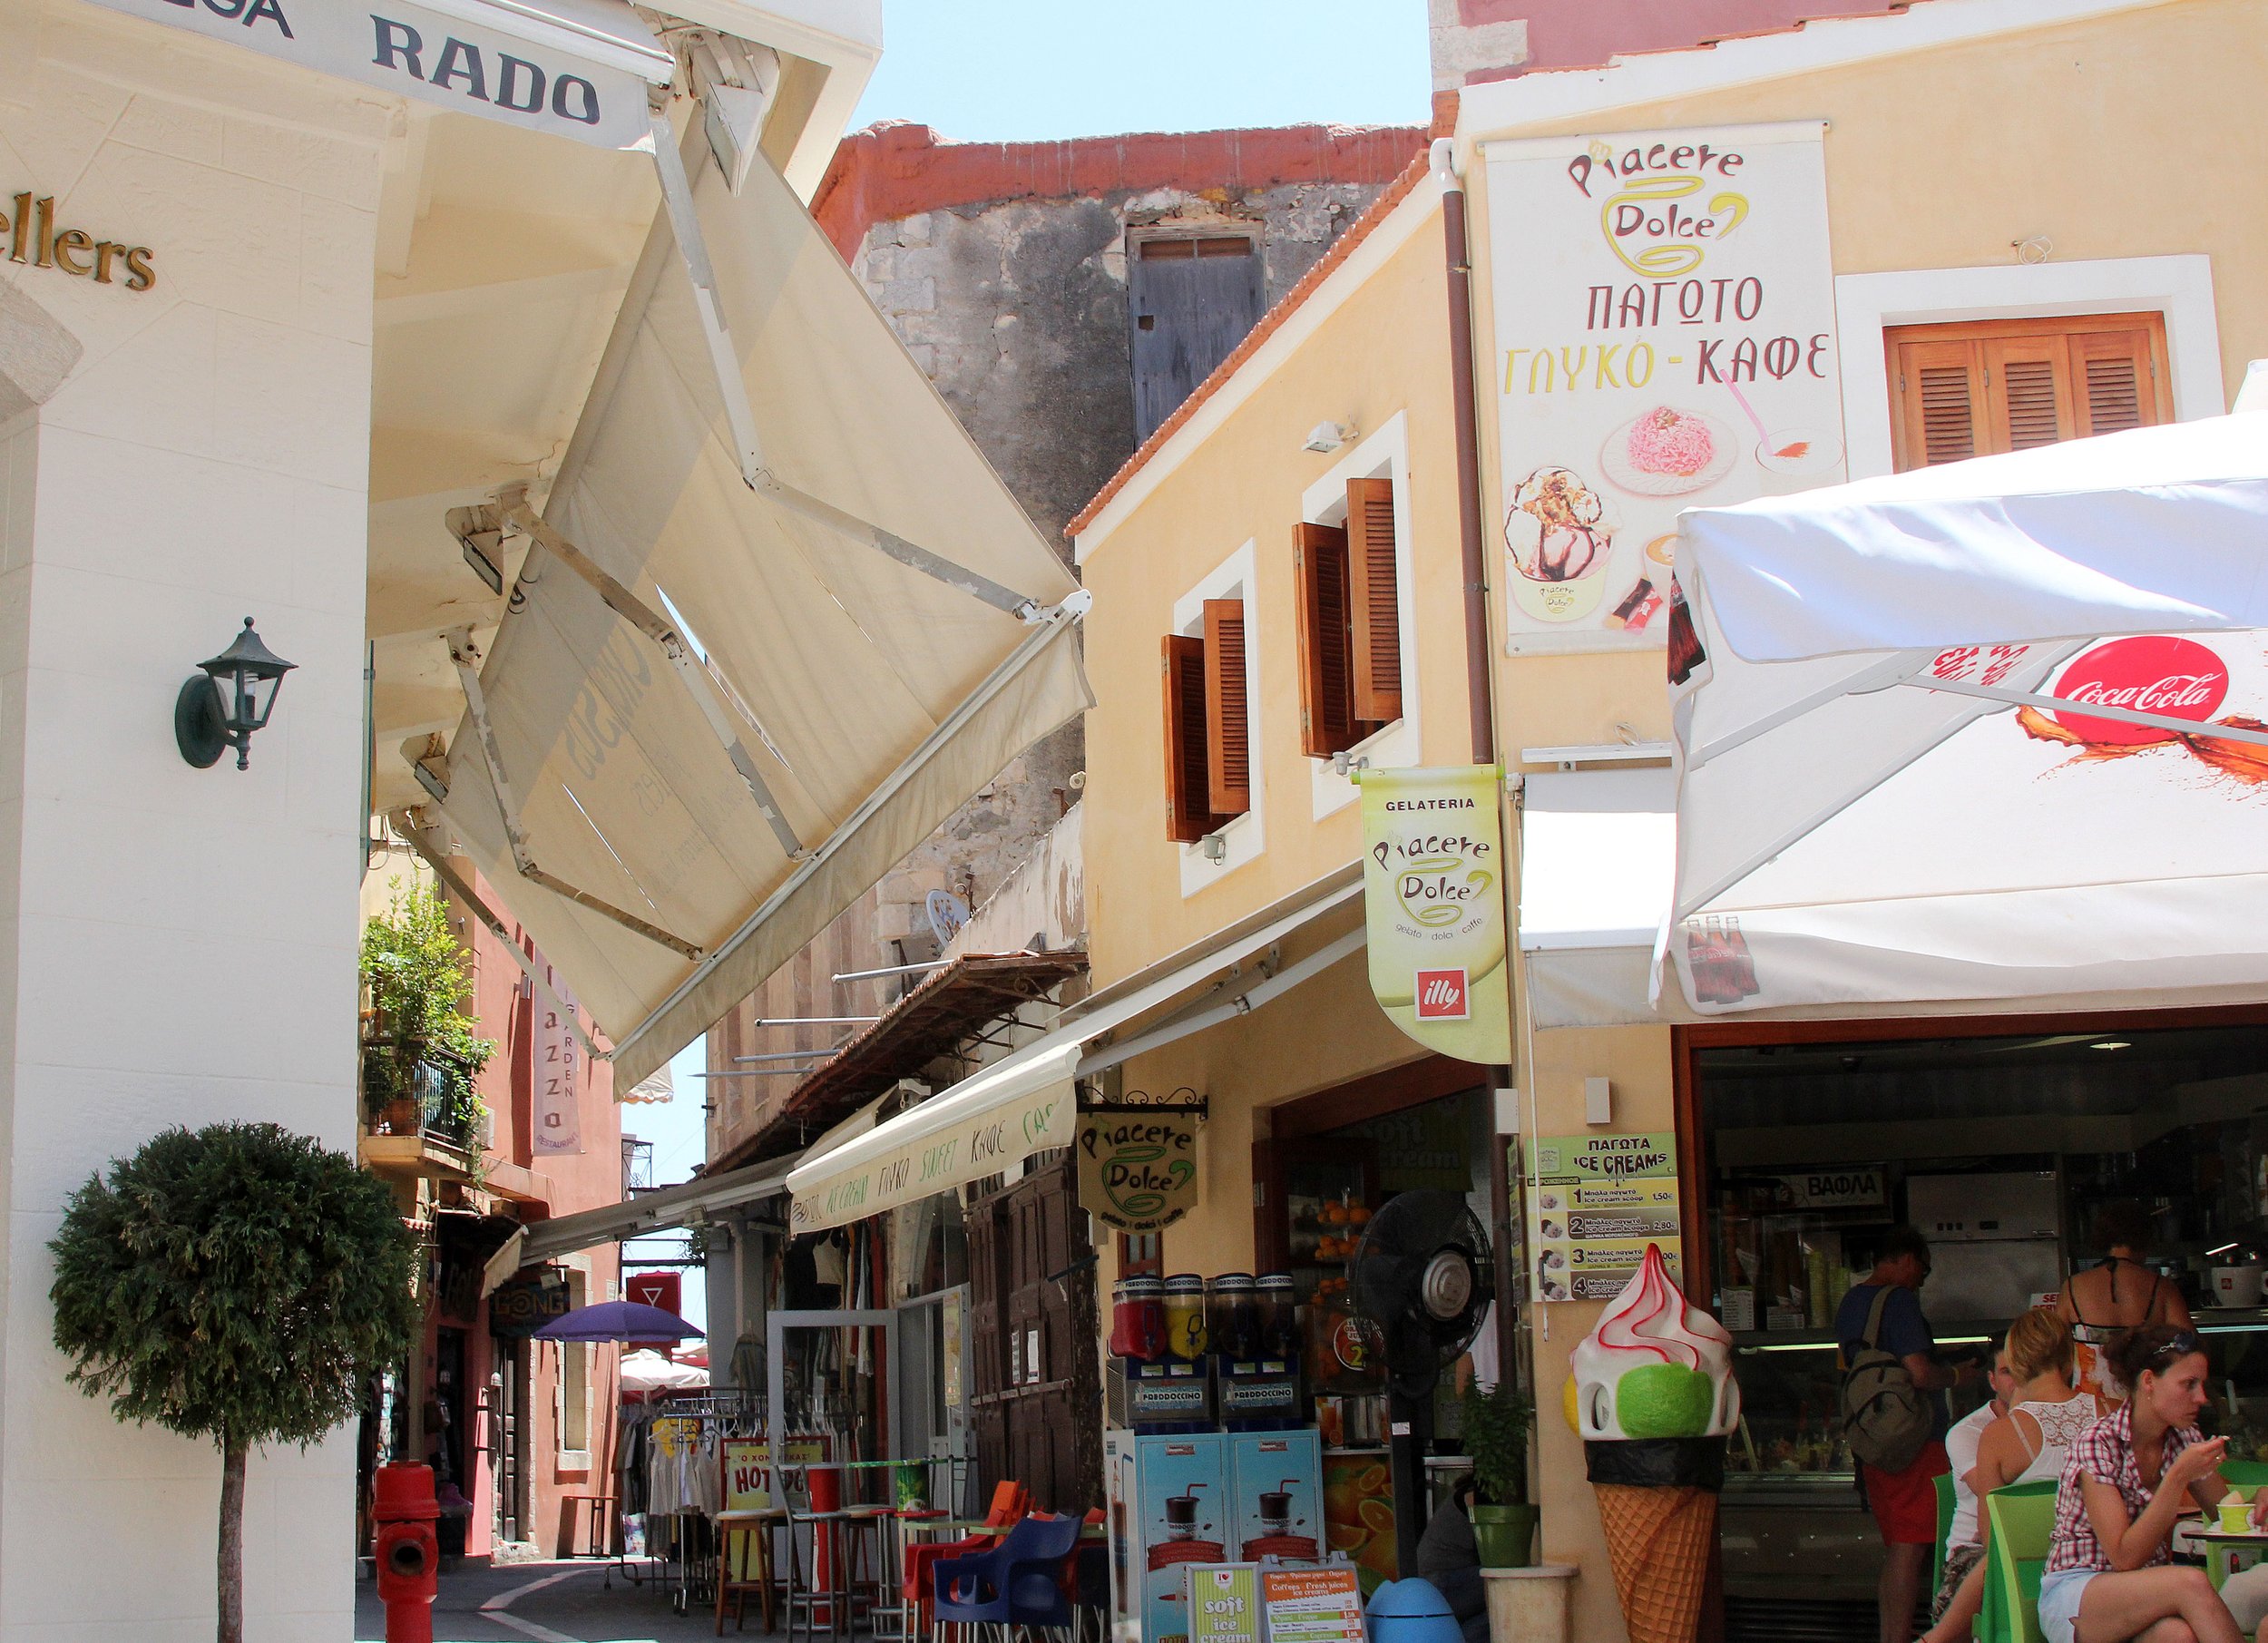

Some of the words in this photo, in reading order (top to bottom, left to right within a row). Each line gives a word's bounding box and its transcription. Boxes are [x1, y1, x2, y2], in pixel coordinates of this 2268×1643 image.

[370, 15, 601, 125] RADO
[1568, 143, 1744, 198] Piacere
[1615, 204, 1715, 238] Dolce
[0, 191, 156, 292] llers
[2066, 668, 2223, 711] Coca-Cola
[1385, 797, 1475, 811] GELATERIA
[1373, 835, 1490, 872] Piacere
[1403, 876, 1471, 901] Dolce
[1394, 923, 1422, 940] gelato
[1431, 931, 1453, 941] dolci
[1423, 979, 1459, 1011] illy
[563, 1003, 575, 1098] GRDEN
[1080, 1123, 1191, 1159] Piacere
[1589, 1138, 1651, 1151] ΠΑΓΩΤΑ
[1574, 1156, 1598, 1172] ICE
[1603, 1152, 1667, 1177] CREAMS
[1110, 1165, 1173, 1191] Dolce
[1807, 1175, 1877, 1196] ΒΑΦΛΑ
[1572, 1188, 1581, 1203] 1
[1570, 1218, 1584, 1233] 2
[1572, 1248, 1584, 1263] 3
[1574, 1278, 1587, 1293] 4
[1143, 1393, 1200, 1401] FREDDOCCINO
[1234, 1389, 1291, 1399] FREDDOCCINO
[1205, 1597, 1245, 1617] soft
[1213, 1619, 1237, 1631] ice
[1199, 1633, 1251, 1643] cream
